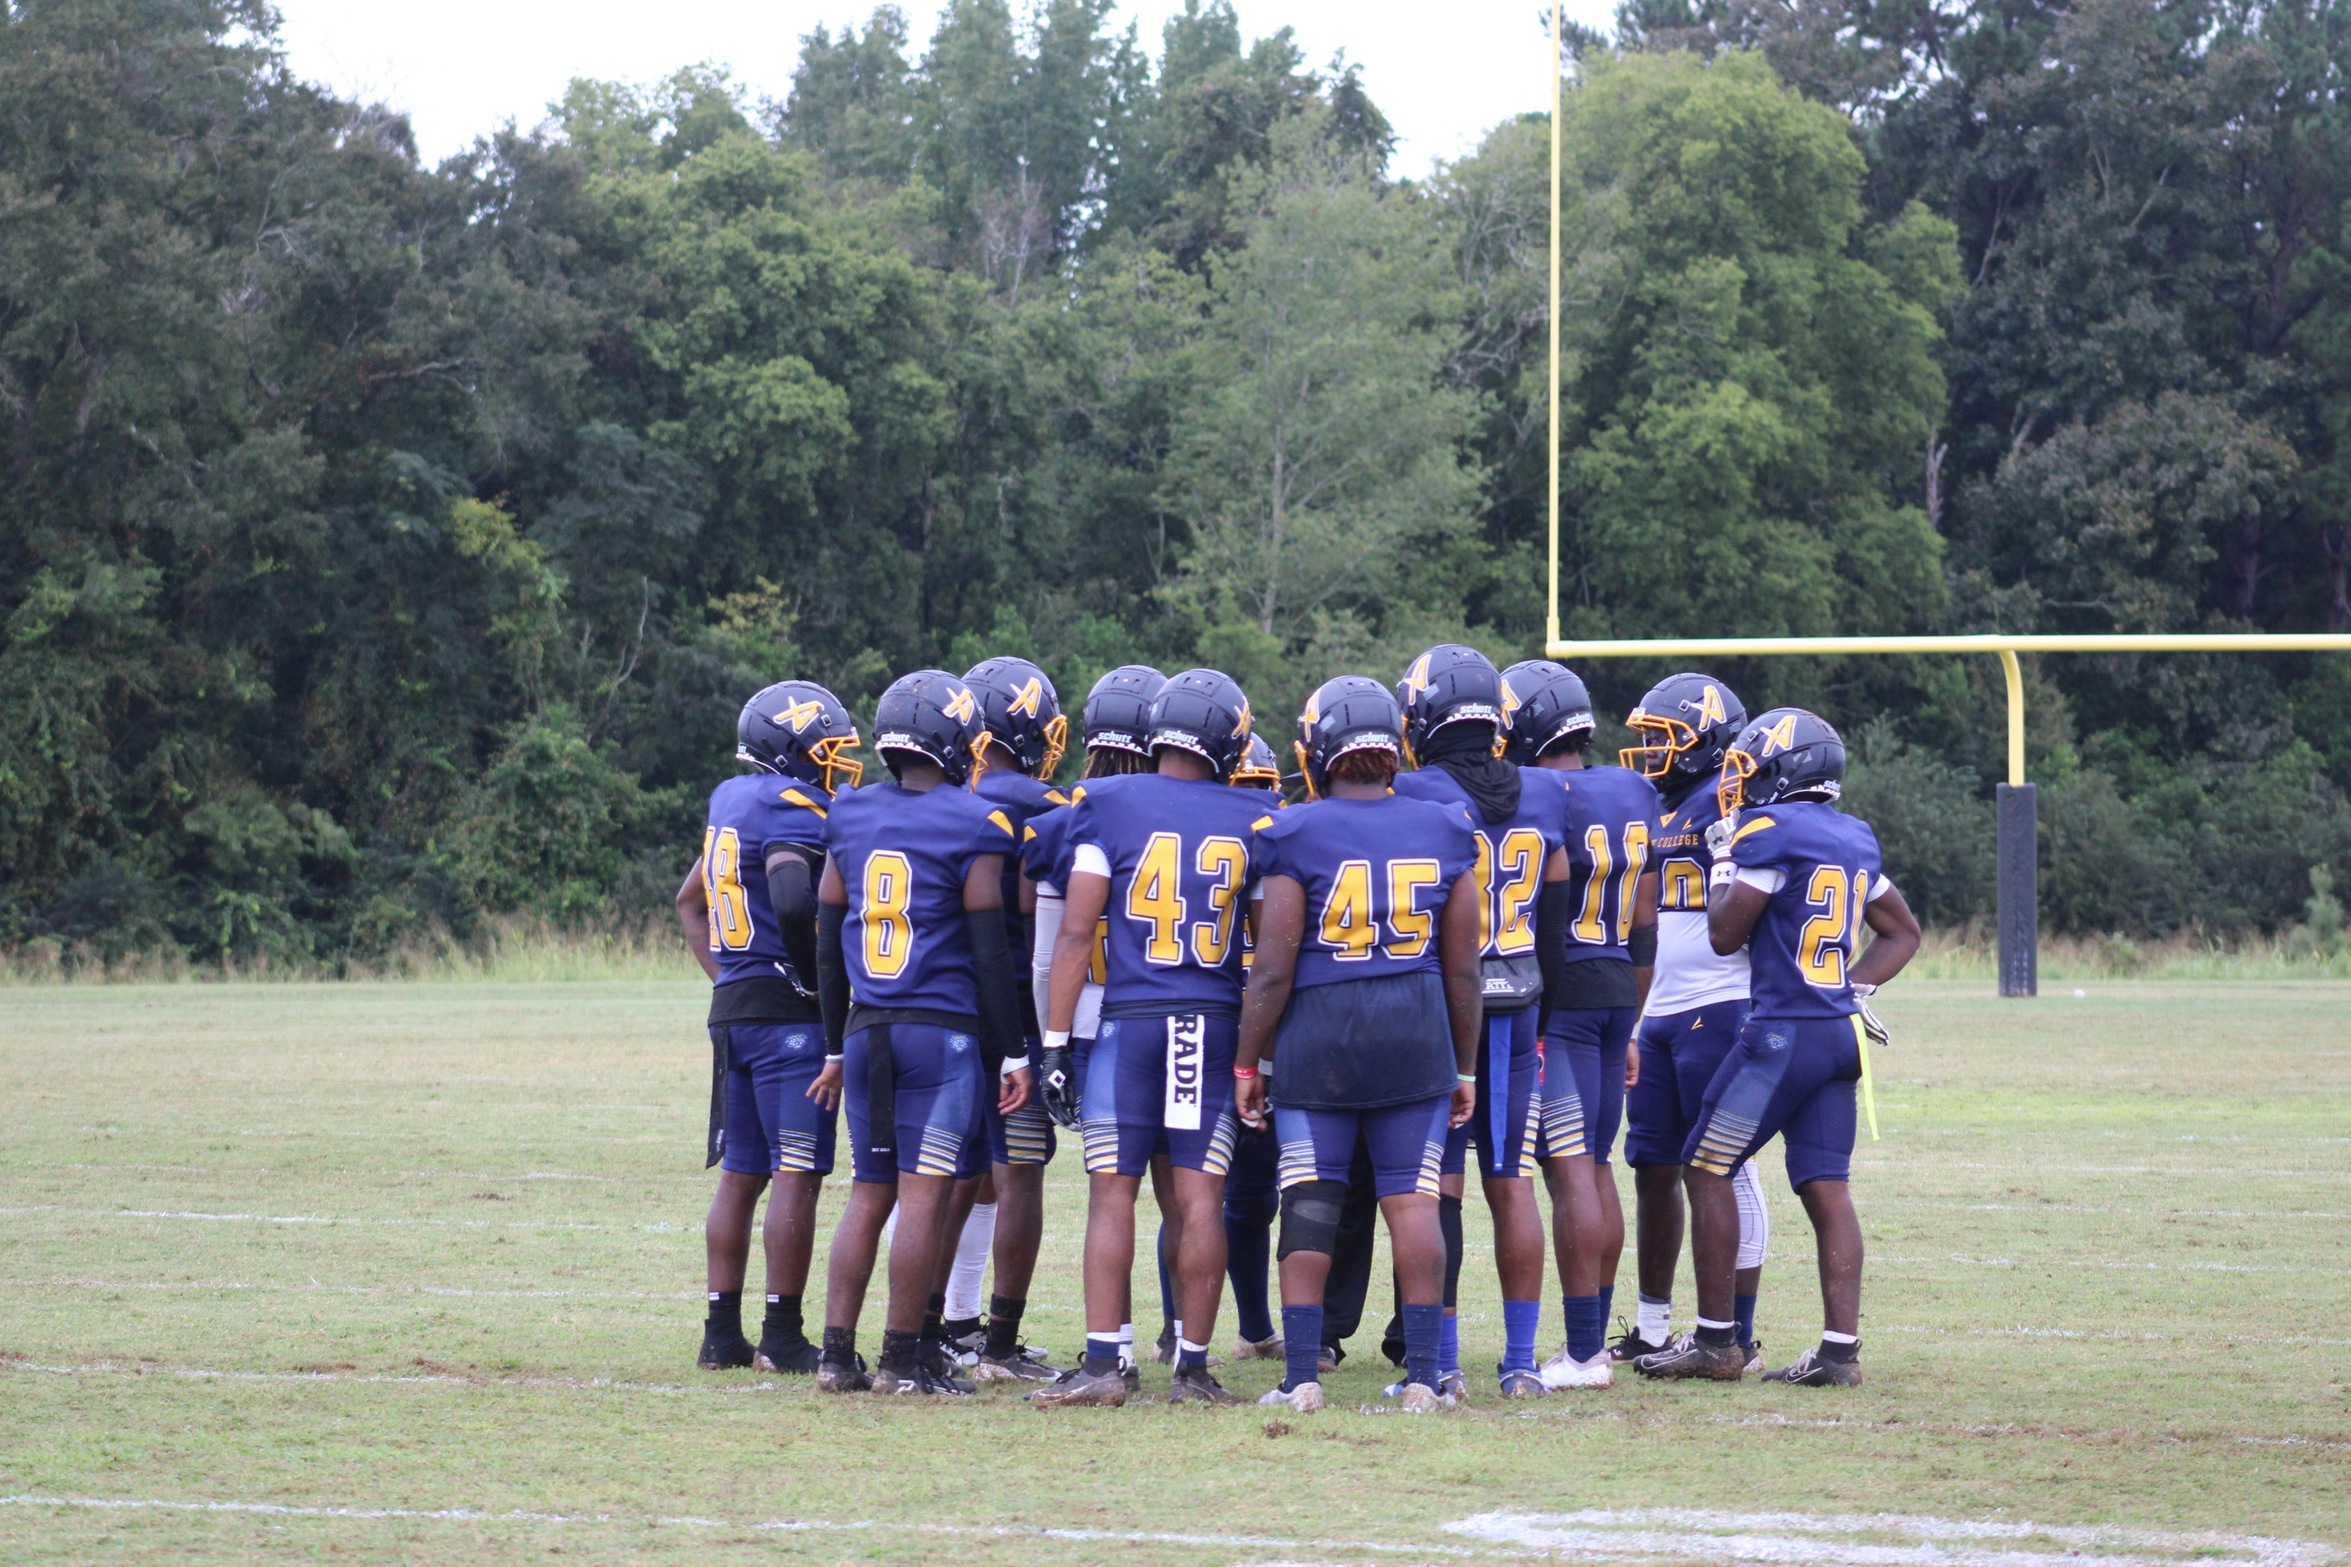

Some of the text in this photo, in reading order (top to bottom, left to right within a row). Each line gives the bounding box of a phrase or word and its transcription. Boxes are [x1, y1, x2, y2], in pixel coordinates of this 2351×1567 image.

[1460, 702, 1493, 715] schutt
[1097, 730, 1133, 744] schutt
[1163, 729, 1200, 745] schutt
[1354, 731, 1390, 744] schutt
[1657, 833, 1699, 848] COLLEGE
[1126, 831, 1250, 968] 43
[860, 849, 914, 980] 8
[1318, 858, 1441, 962] 45
[1795, 864, 1869, 989] 21
